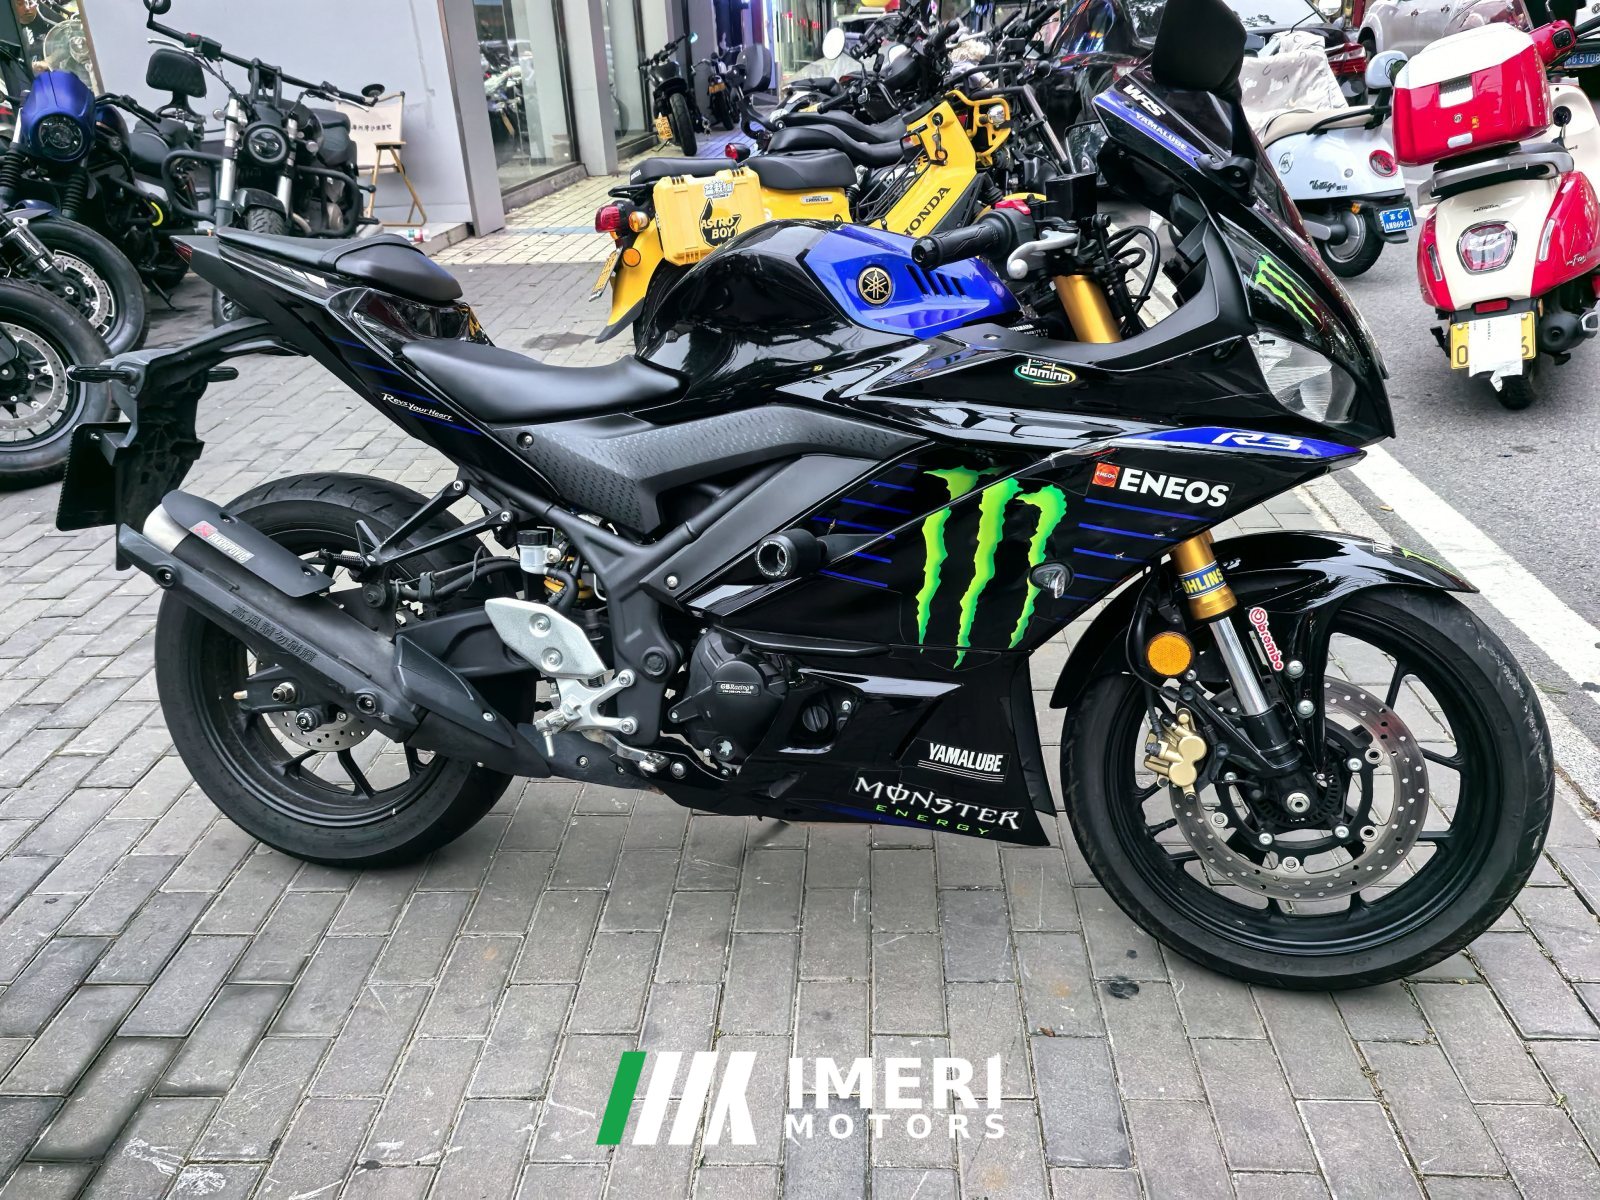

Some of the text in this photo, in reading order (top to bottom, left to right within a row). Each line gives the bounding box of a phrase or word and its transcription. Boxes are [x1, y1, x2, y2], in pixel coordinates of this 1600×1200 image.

[1135, 112, 1188, 151] YAMALUBE
[711, 226, 733, 239] BOY
[1020, 358, 1070, 382] domino
[381, 392, 408, 407] Revs
[408, 403, 429, 415] Your
[1211, 431, 1304, 451] R3
[1118, 467, 1230, 507] ENEOS
[1256, 621, 1284, 671] brembo
[929, 742, 1004, 772] YAMALUBE
[854, 776, 1020, 830] MONSTER
[875, 803, 990, 835] ENERGY
